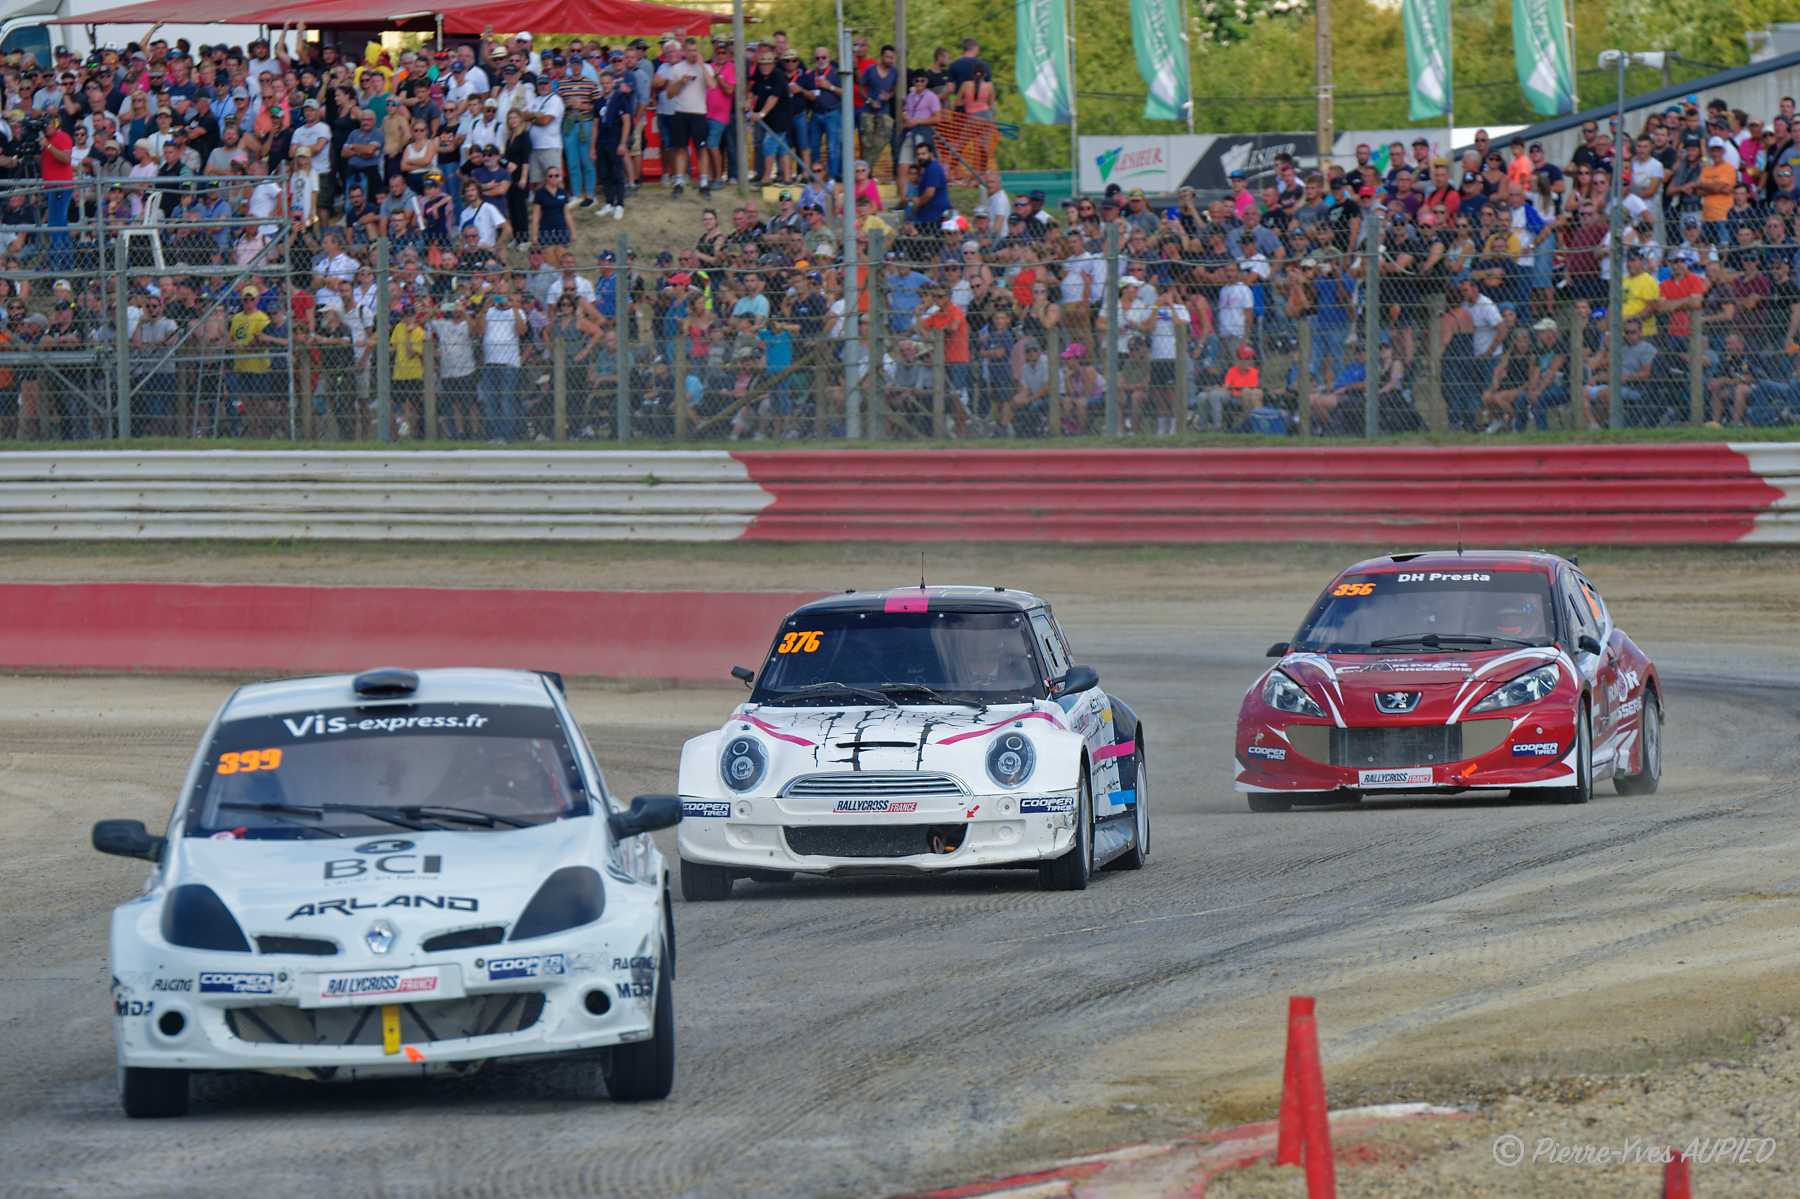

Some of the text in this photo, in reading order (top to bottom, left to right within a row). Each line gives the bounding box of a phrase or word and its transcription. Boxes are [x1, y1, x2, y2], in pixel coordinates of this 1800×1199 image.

[1397, 573, 1490, 582] DH Presta
[1332, 583, 1376, 597] 356
[778, 630, 824, 653] 376
[1248, 746, 1286, 757] COOPER
[1513, 742, 1559, 751] COOPER
[216, 747, 284, 776] 399
[1363, 773, 1408, 783] RALLYCROSS
[837, 800, 917, 812] RALLYCROSS FRANCE
[1021, 798, 1073, 809] COOPER
[1046, 805, 1073, 813] TIRES
[703, 809, 729, 817] TIRES
[323, 854, 442, 880] BCI
[286, 894, 479, 921] ARLAND
[201, 974, 273, 986] COOPER
[328, 975, 399, 994] RALLYCROSS
